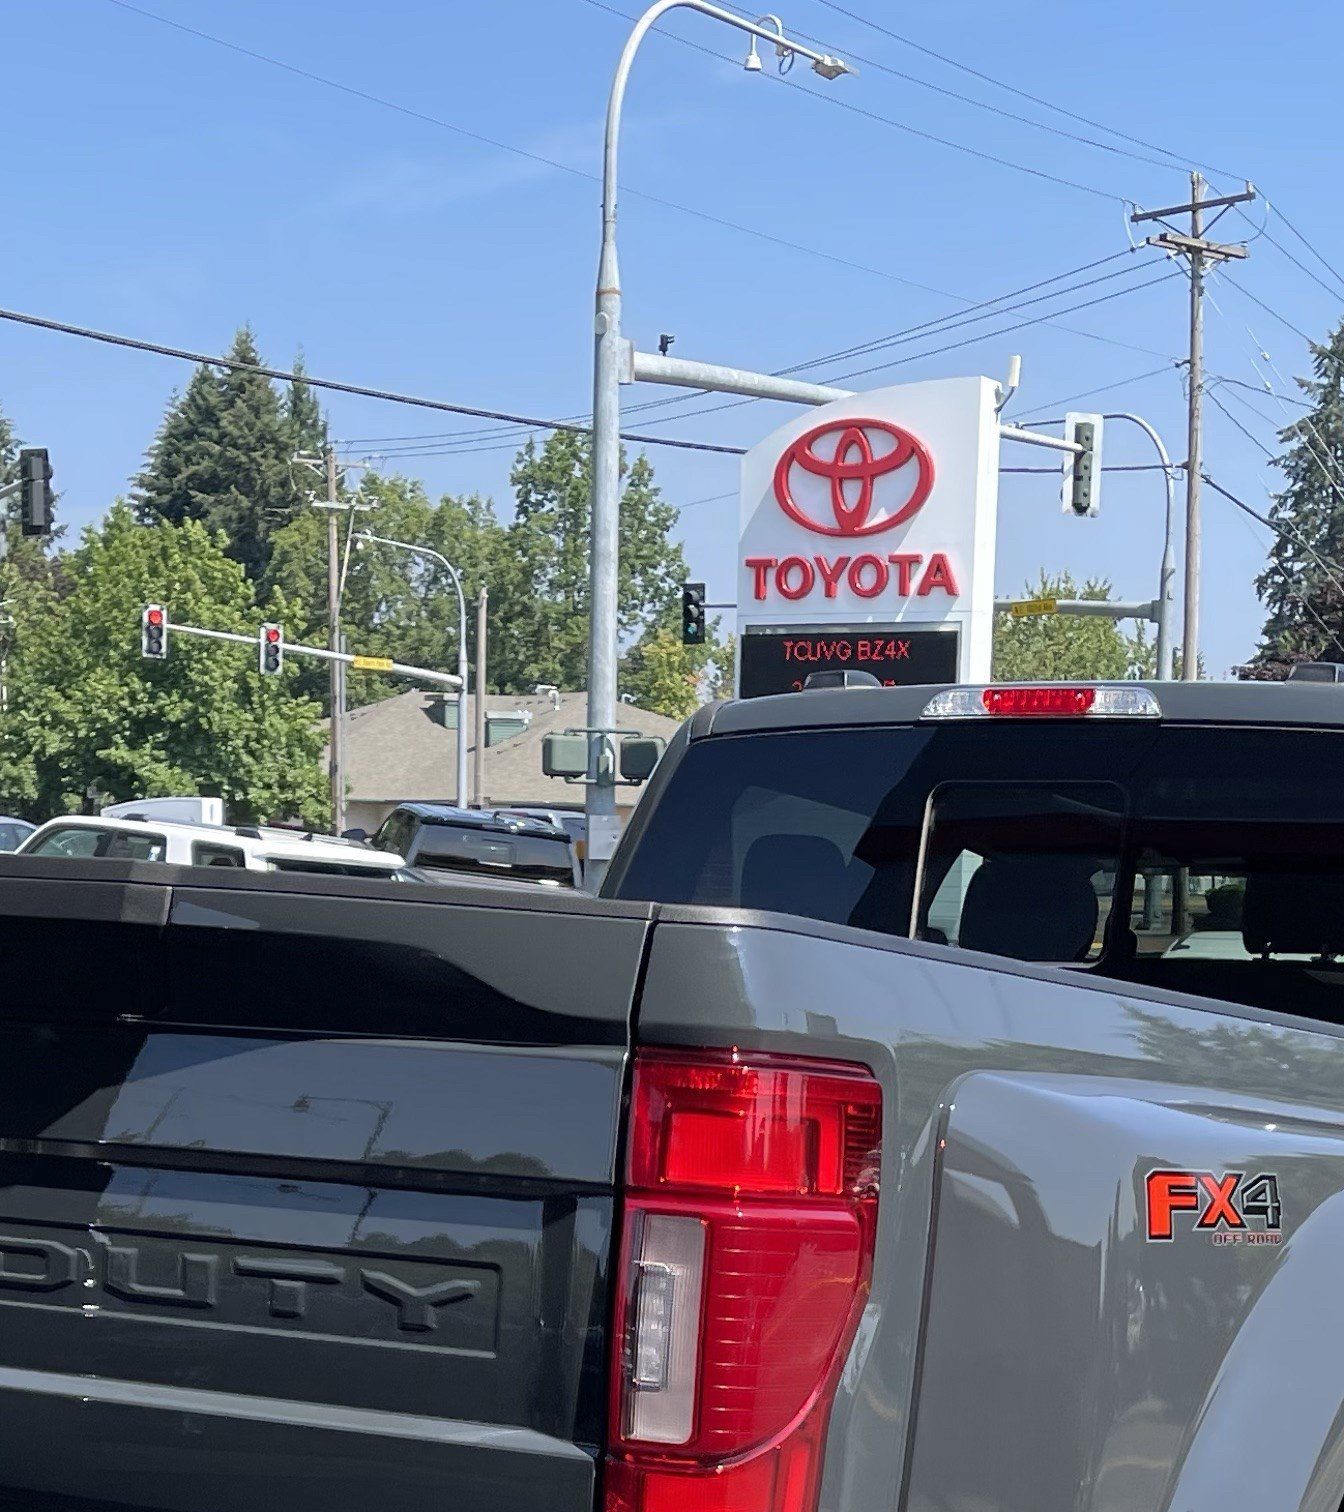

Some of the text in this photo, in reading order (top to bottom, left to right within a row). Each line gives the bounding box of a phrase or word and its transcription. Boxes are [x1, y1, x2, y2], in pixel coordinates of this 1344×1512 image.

[745, 553, 960, 600] TOYOTA
[857, 639, 911, 661] BZ4X
[1144, 1168, 1283, 1243] FX4
[1212, 1231, 1284, 1247] OFF ROAD
